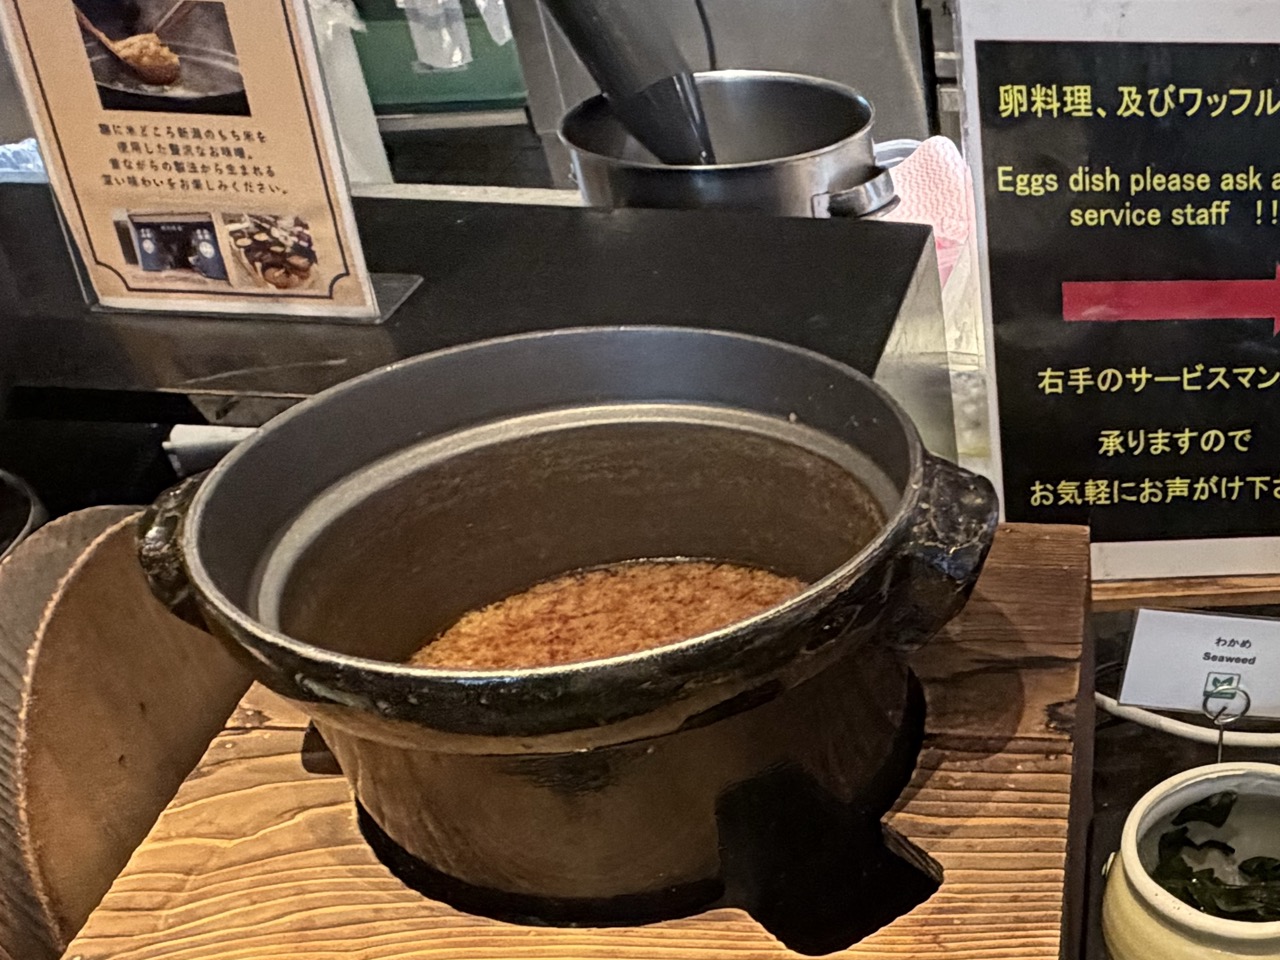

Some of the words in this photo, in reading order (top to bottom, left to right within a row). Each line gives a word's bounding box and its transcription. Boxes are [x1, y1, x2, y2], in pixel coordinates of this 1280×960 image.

[997, 166, 1059, 196] Eggs
[1068, 166, 1121, 192] dish
[1130, 166, 1211, 196] please
[1220, 165, 1263, 191] ask
[1070, 201, 1162, 227] service
[1170, 200, 1230, 226] staff
[1097, 428, 1253, 456] 承りますので
[1214, 636, 1252, 649] わかめ
[1202, 652, 1257, 666] Seaweed
